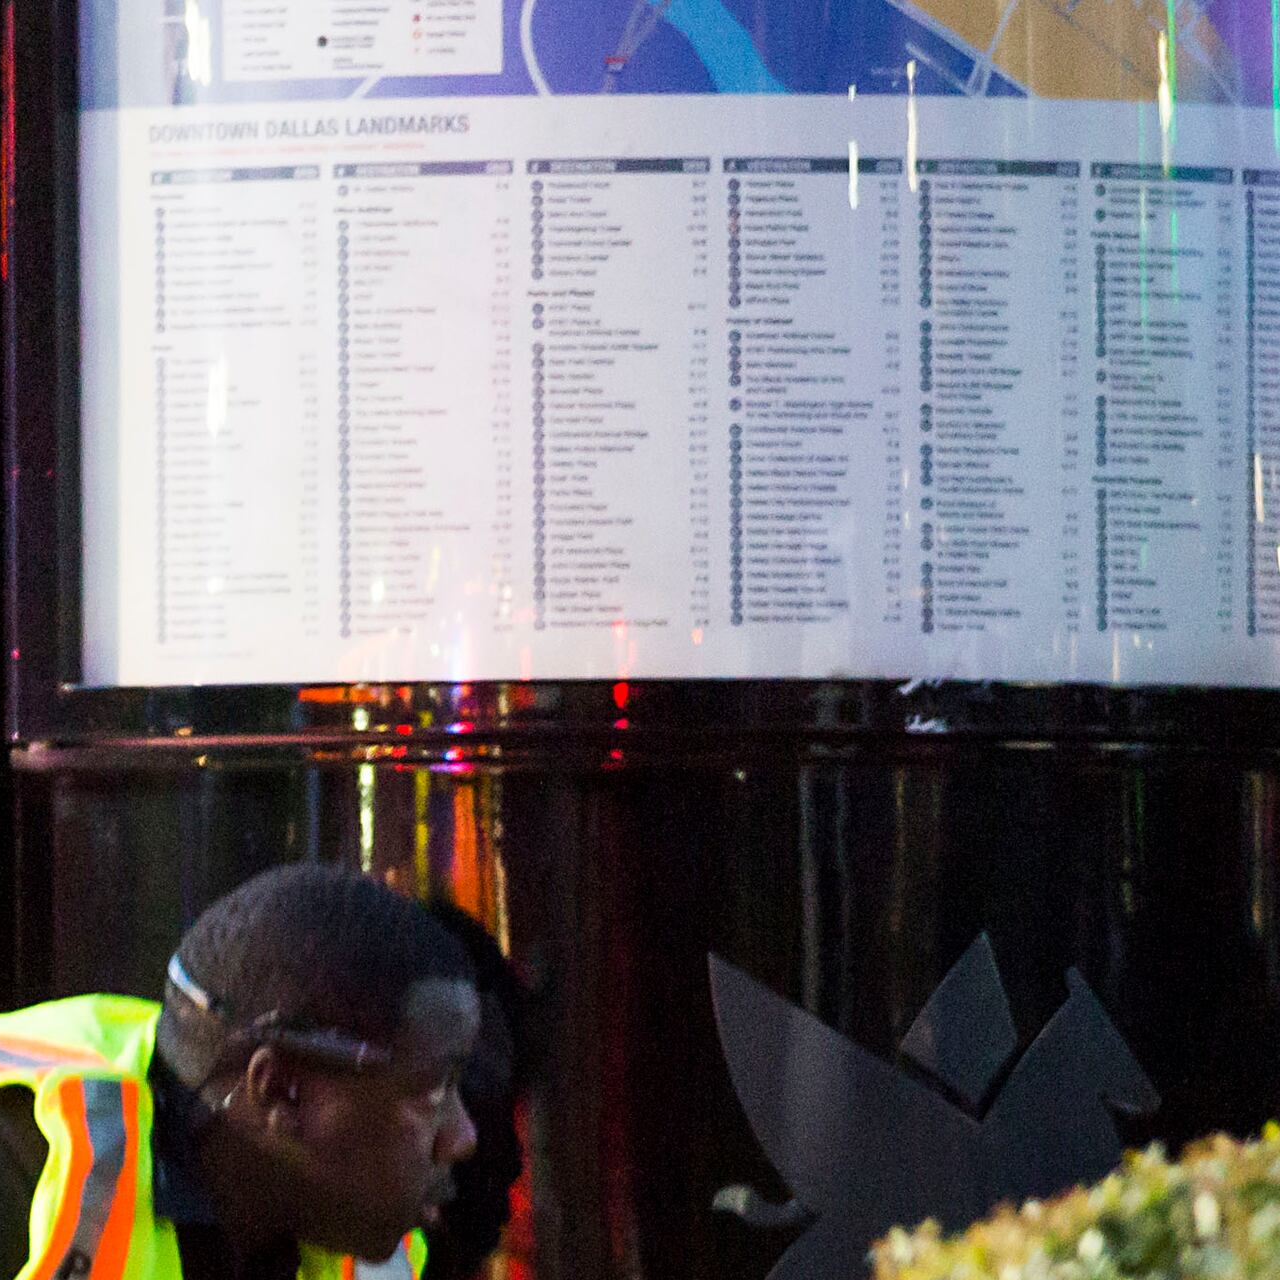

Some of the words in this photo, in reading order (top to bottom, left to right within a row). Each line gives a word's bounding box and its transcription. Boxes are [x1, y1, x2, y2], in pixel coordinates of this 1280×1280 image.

[148, 120, 260, 145] DOWNTOWN
[266, 117, 338, 140] DALLAS
[345, 113, 470, 137] LANDMARKS
